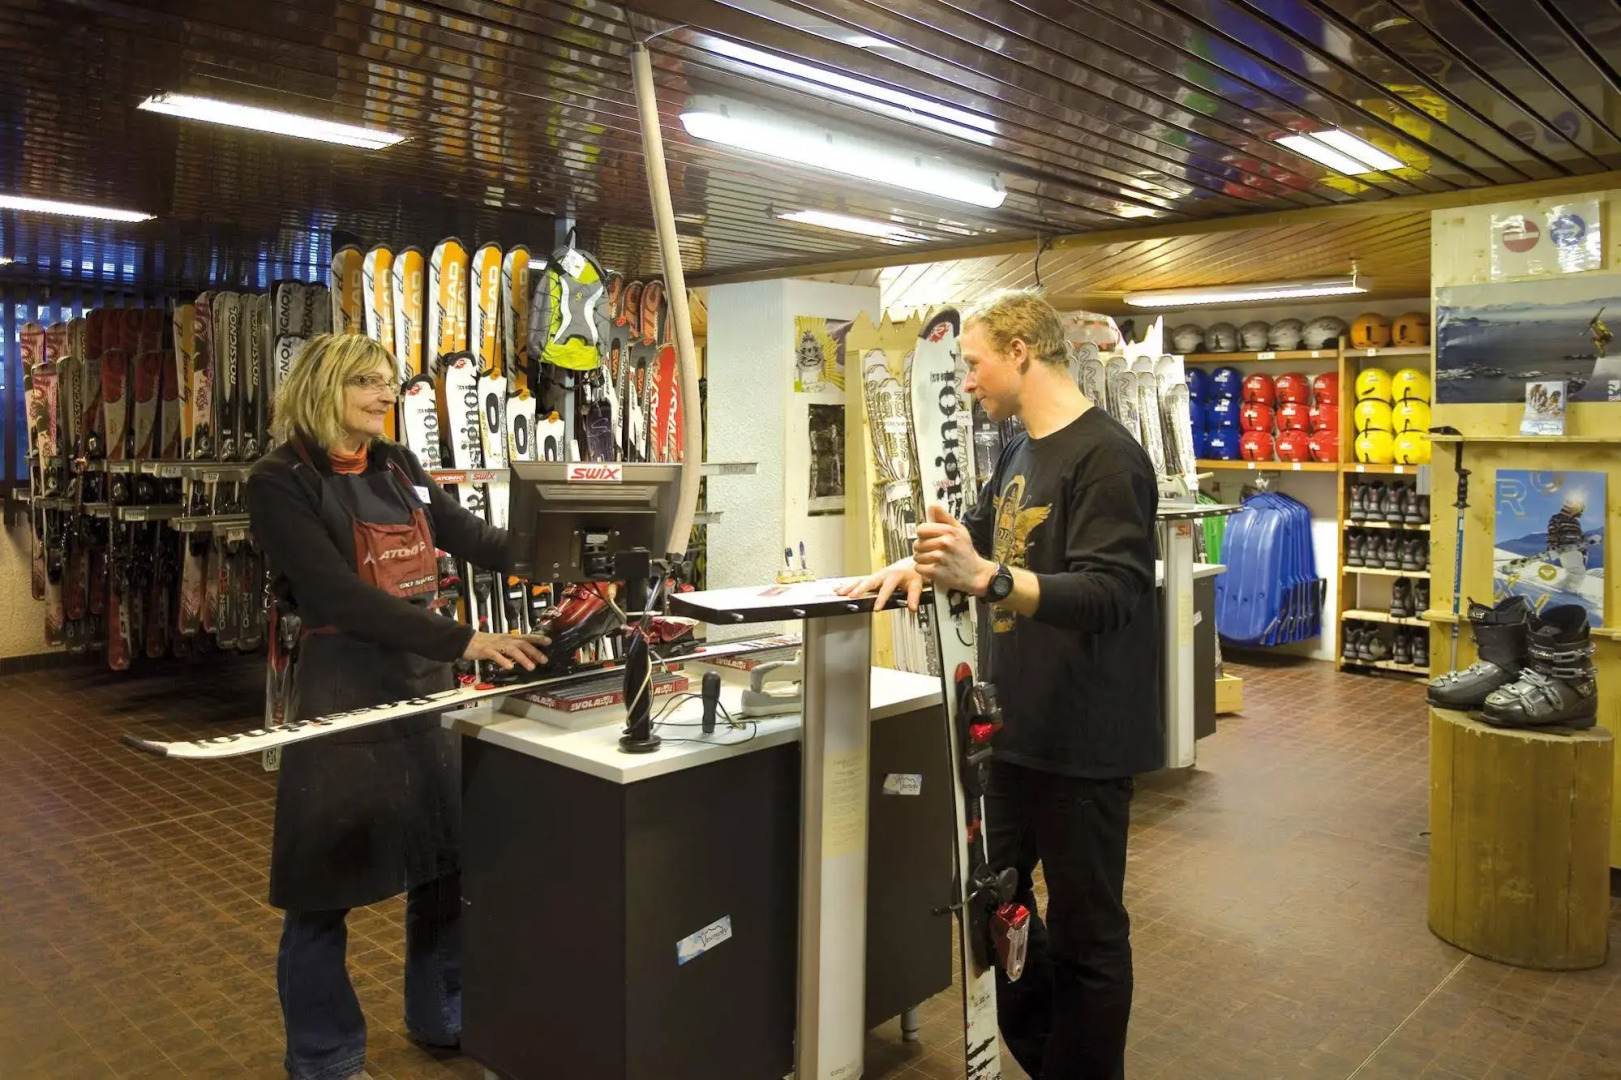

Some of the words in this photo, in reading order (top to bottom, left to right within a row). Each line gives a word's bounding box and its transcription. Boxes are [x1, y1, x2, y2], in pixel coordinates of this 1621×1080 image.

[383, 268, 394, 343] HEAD
[411, 270, 422, 344] HEAD
[446, 261, 459, 335] HEAD
[487, 265, 498, 337] HEAD
[229, 306, 240, 385] ROSSIGNOL
[250, 310, 260, 386] ROSSIGNOL
[72, 367, 82, 435] ROSSIGNOL
[618, 347, 628, 429] ROSSIGNOL
[434, 475, 465, 483] ATOMIC
[572, 698, 601, 711] VOLA
